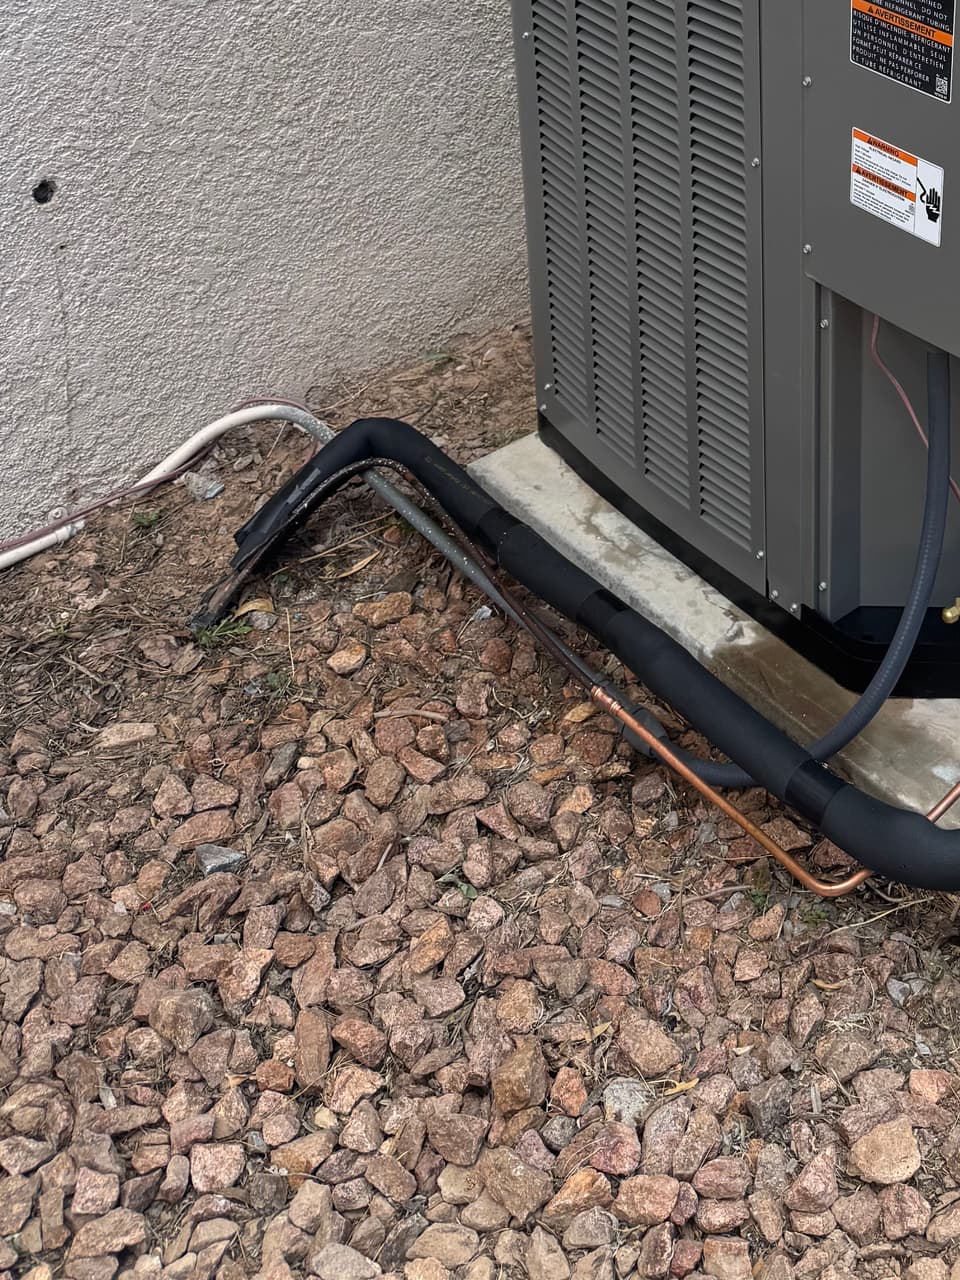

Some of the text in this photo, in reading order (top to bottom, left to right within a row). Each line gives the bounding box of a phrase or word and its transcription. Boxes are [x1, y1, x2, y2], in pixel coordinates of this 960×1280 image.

[853, 10, 873, 24] RISQUE
[875, 7, 936, 38] AVERTISSEMENT
[884, 0, 925, 22] REFRIGERANT
[927, 17, 952, 33] TUBING.
[922, 6, 931, 15] DO
[933, 11, 948, 21] NOT
[853, 28, 861, 36] UN
[864, 32, 898, 51] PERSONNEL
[862, 58, 877, 69] TUBE
[873, 44, 886, 55] PEUT
[914, 62, 922, 70] CE
[930, 50, 946, 62] SEUL
[880, 57, 886, 65] NE
[889, 60, 899, 70] PAS
[900, 65, 930, 82] PERFORER
[871, 138, 899, 157] WARNING
[862, 168, 908, 198] AVERTISSEMENT
